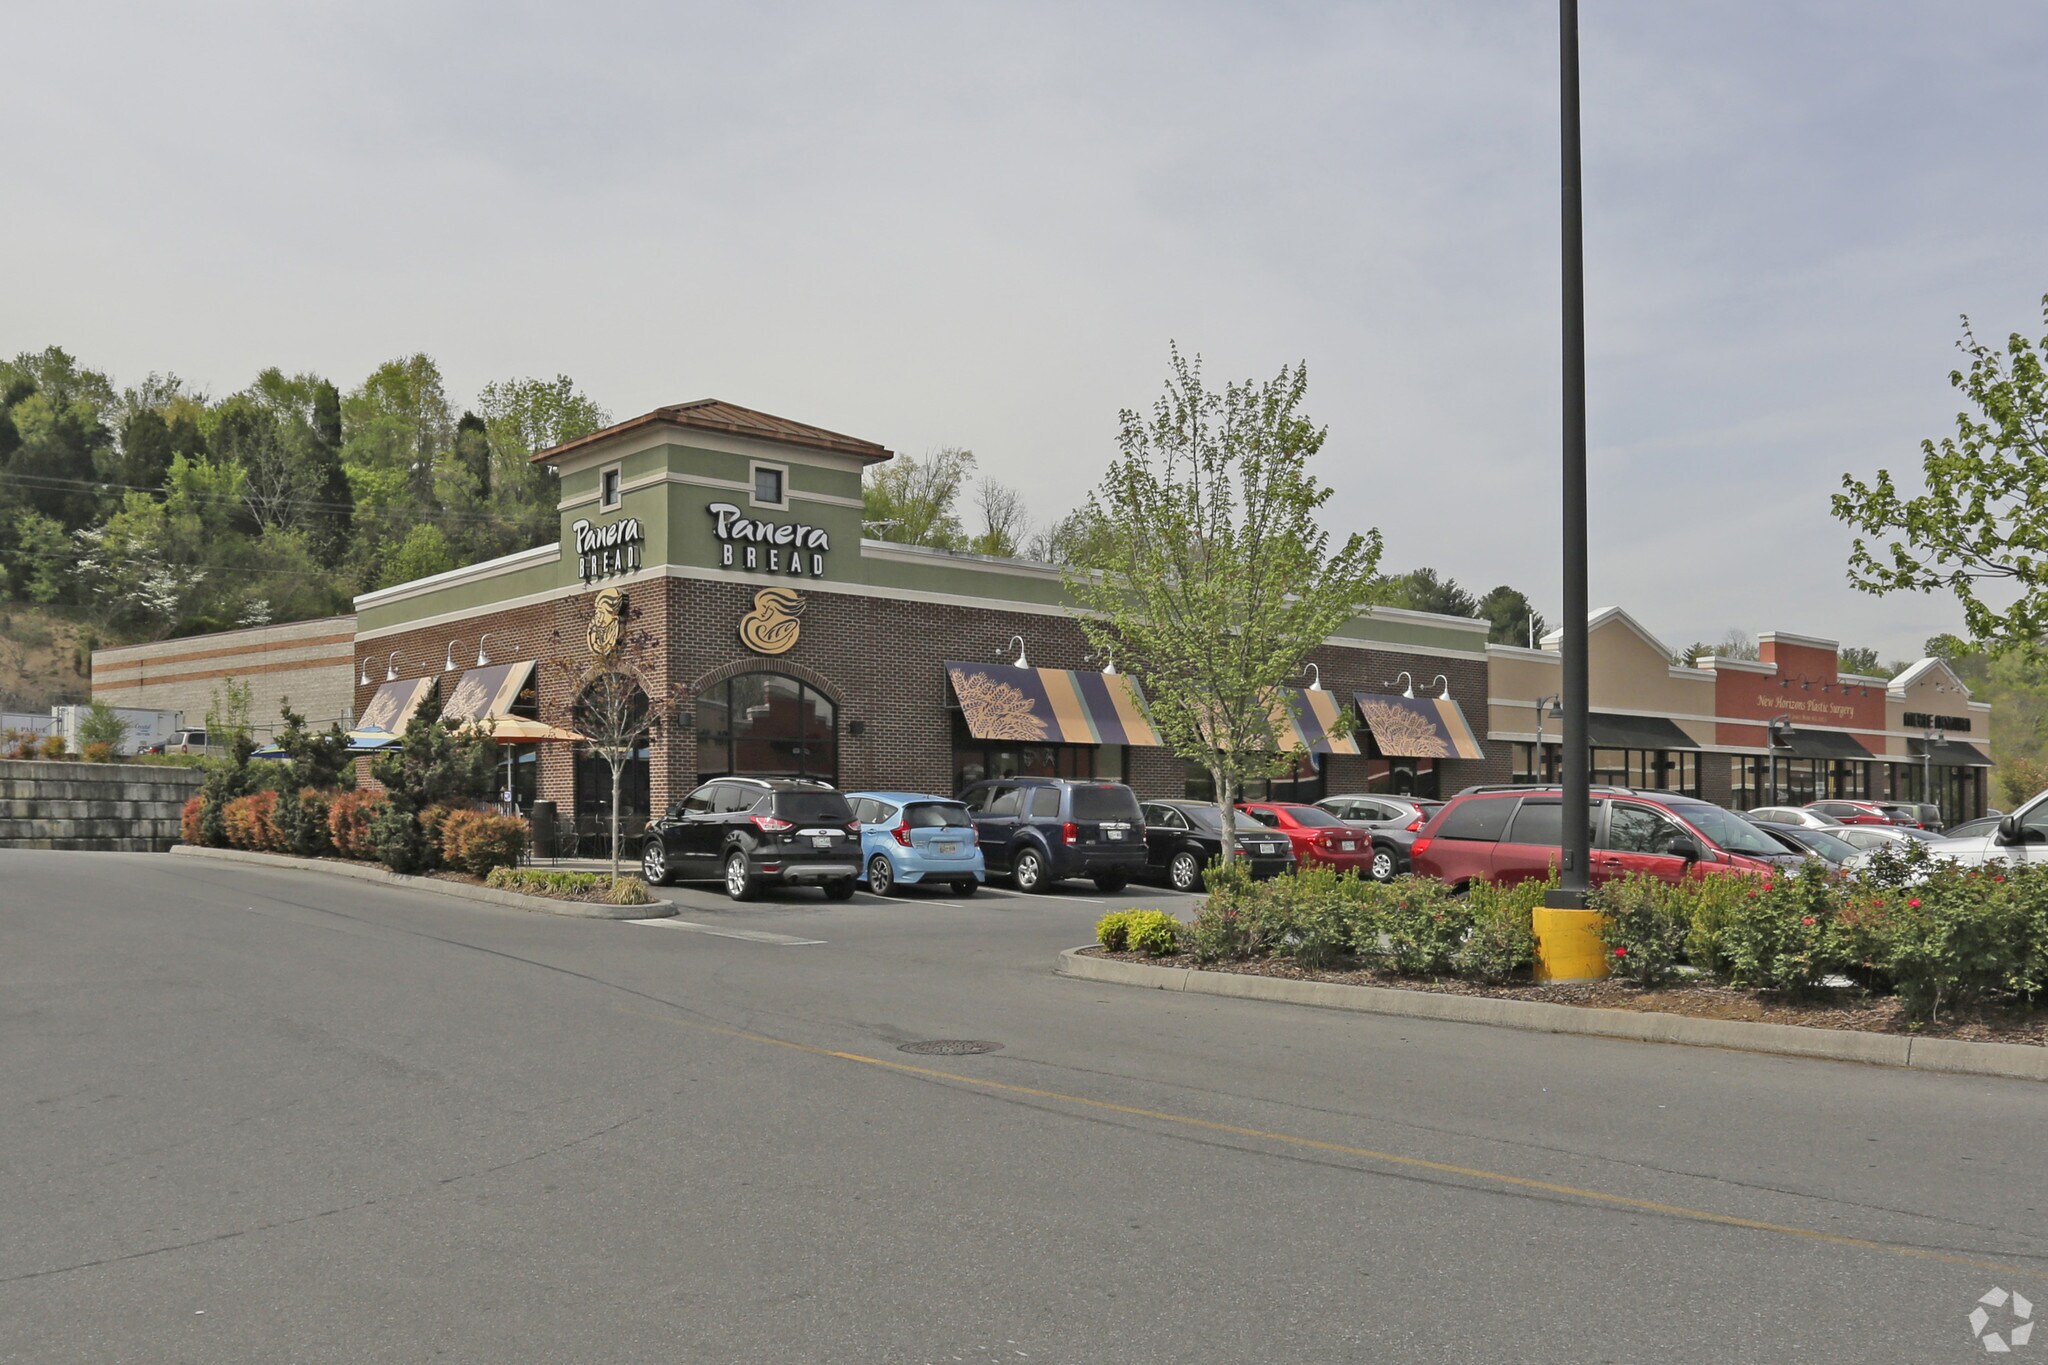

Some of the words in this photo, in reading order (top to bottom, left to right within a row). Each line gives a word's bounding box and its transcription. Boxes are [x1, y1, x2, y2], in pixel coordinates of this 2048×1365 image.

[572, 518, 641, 554] Panera
[707, 501, 829, 551] Panera
[578, 545, 638, 579] BREAD
[721, 543, 824, 577] BREAD
[1757, 694, 1774, 707] New
[1775, 695, 1806, 710] Horizons
[1806, 698, 1829, 713] Plastic
[1829, 702, 1855, 719] Surgery
